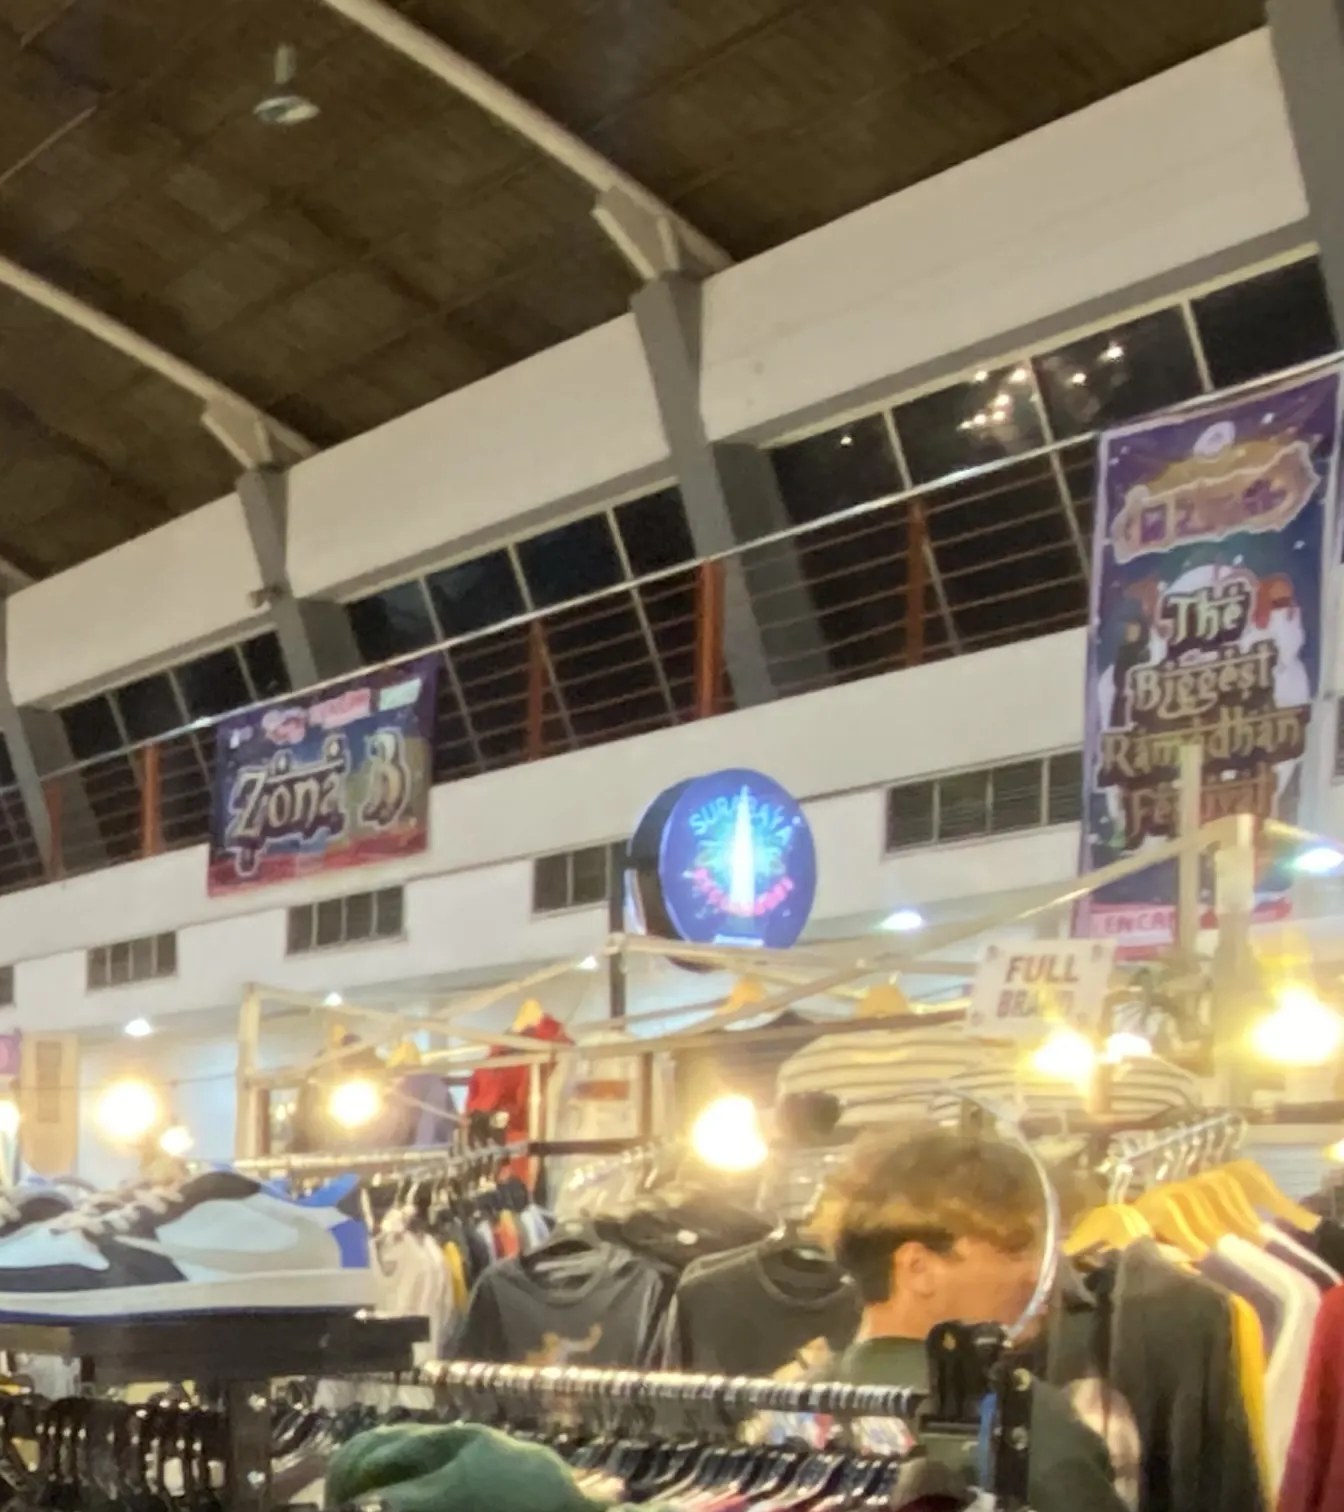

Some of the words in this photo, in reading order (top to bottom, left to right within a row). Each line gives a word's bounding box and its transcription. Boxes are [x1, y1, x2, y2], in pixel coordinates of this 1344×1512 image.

[1163, 586, 1248, 643] The
[1133, 640, 1275, 719] Biggest
[1102, 705, 1304, 778] Ramadhan
[232, 755, 346, 839] Zona
[366, 731, 410, 827] B
[1128, 768, 1274, 836] Feival
[1005, 954, 1080, 984] FULL
[996, 989, 1076, 1019] BRAD
